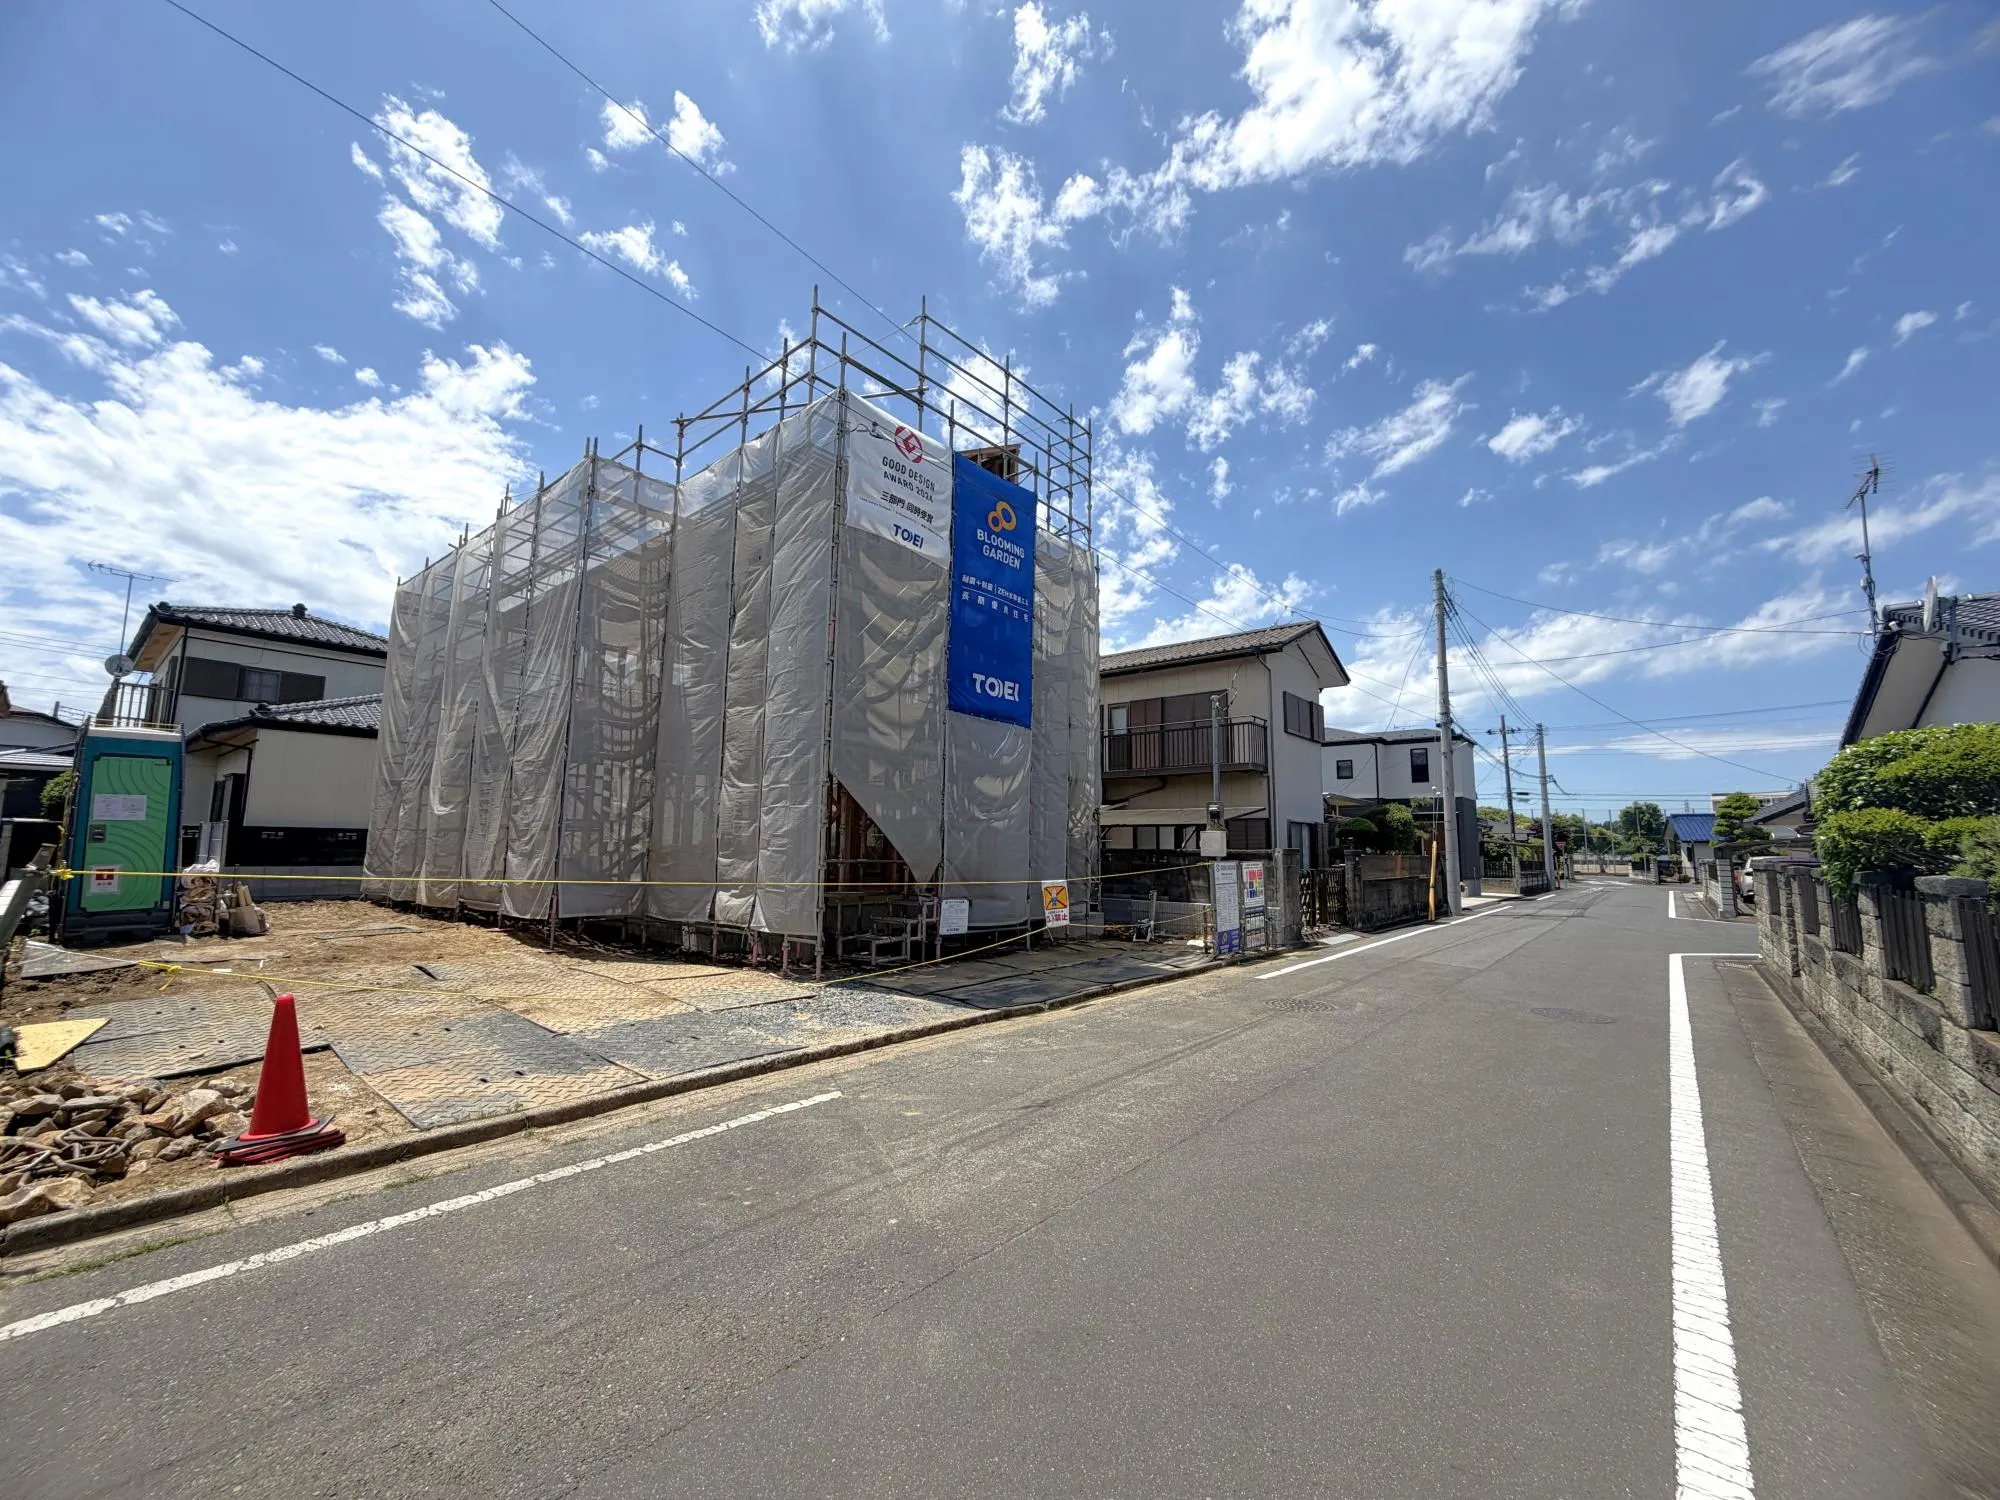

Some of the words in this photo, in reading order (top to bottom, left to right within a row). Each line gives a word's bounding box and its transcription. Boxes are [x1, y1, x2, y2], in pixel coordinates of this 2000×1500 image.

[882, 456, 906, 475] GOOD
[908, 468, 935, 492] DESIGN
[884, 471, 914, 491] AWARD
[915, 486, 934, 503] 2024
[893, 523, 924, 549] TOEI
[976, 528, 1025, 559] BLOOMING
[982, 544, 1021, 571] GARDEN
[972, 672, 1020, 702] TOEI
